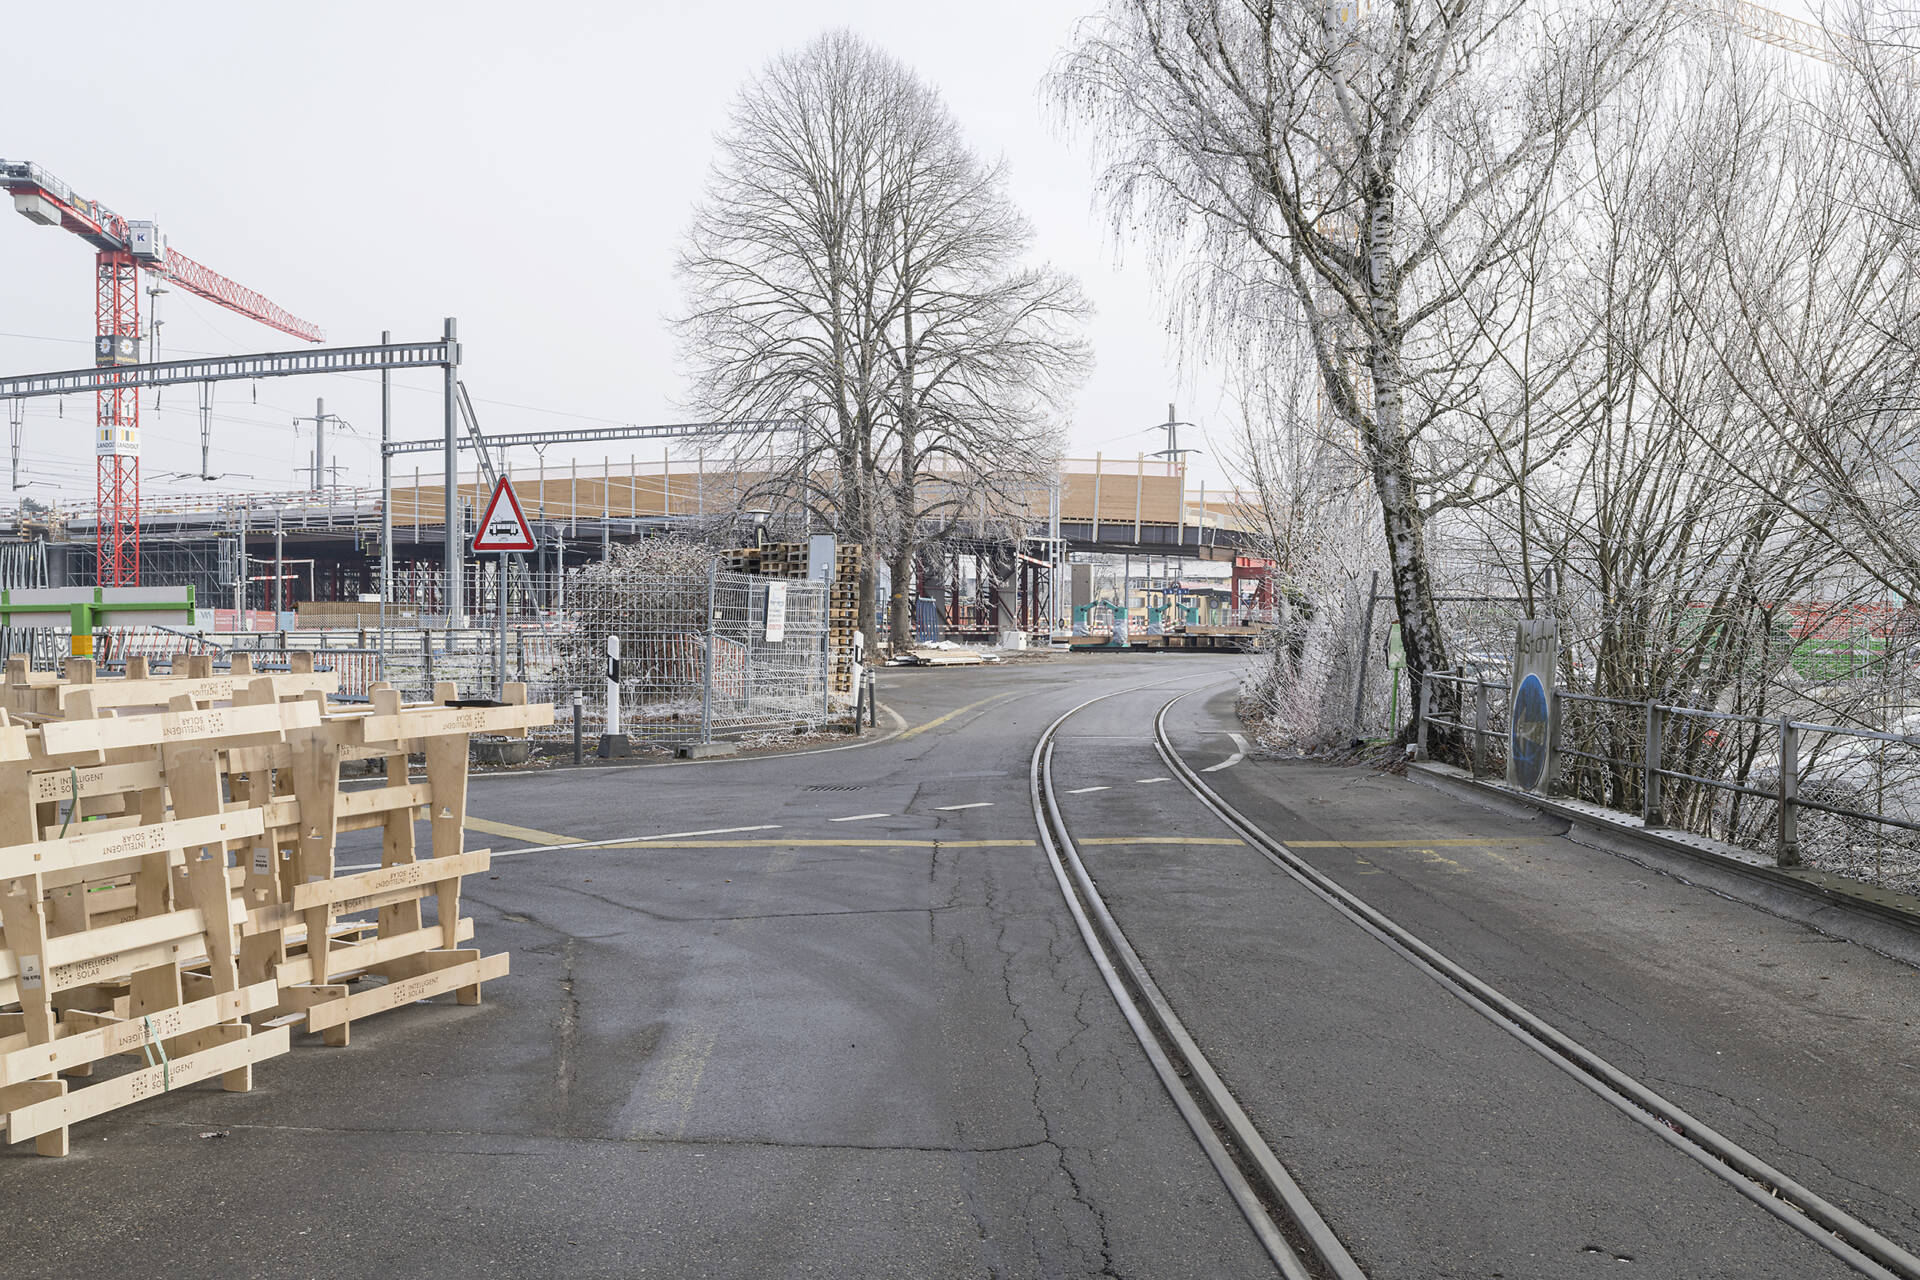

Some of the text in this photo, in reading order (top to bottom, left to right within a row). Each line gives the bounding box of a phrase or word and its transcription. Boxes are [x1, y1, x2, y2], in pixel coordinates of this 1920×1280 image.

[104, 403, 109, 416] 1
[125, 404, 130, 416] 1
[182, 717, 204, 725] SOLAR
[162, 724, 205, 736] INTELLIGENT
[60, 772, 104, 785] INTLLIGENT
[60, 783, 85, 793] SOAR
[122, 832, 145, 843] SOLAR
[103, 841, 146, 855] INTELLIGENT
[390, 870, 407, 879] SOLAR
[76, 953, 119, 971] INTELLIGENT
[76, 967, 101, 979] SOLAR
[138, 1018, 161, 1032] SOAR
[152, 1061, 194, 1080] INTLIGENT
[152, 1075, 175, 1090] SOR
